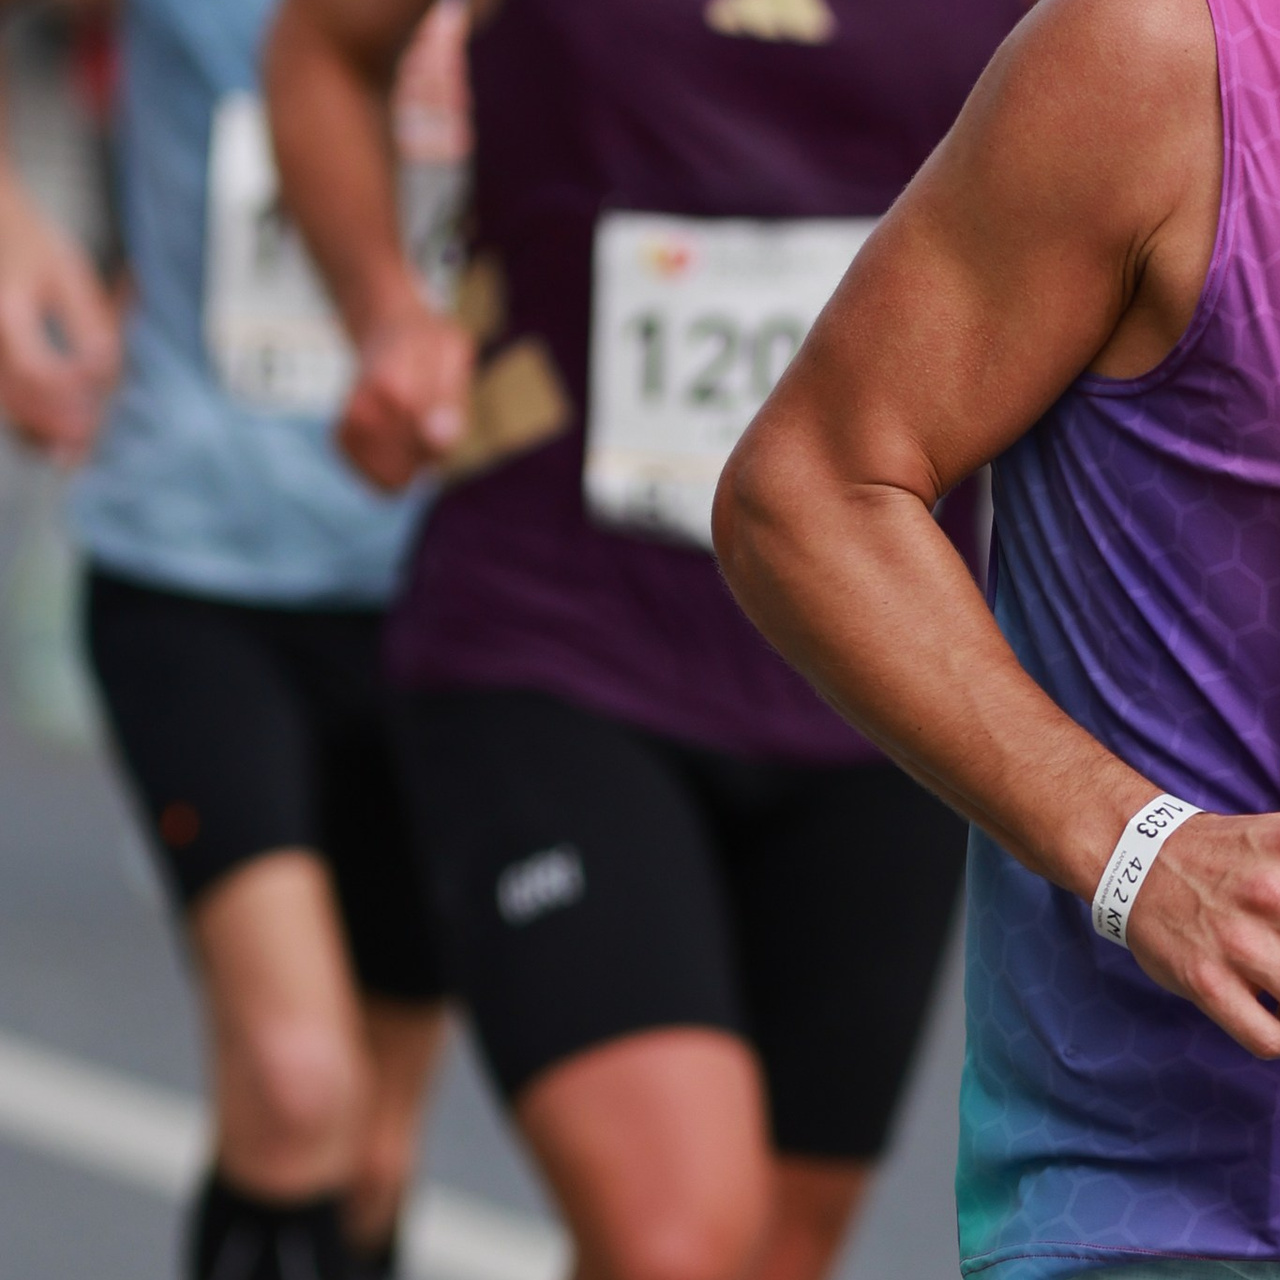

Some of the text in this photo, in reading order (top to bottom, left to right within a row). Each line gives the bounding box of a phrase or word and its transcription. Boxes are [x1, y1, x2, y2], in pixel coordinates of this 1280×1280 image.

[630, 310, 810, 410] 120
[1136, 801, 1184, 839] 1433
[1112, 856, 1143, 904] 42,2
